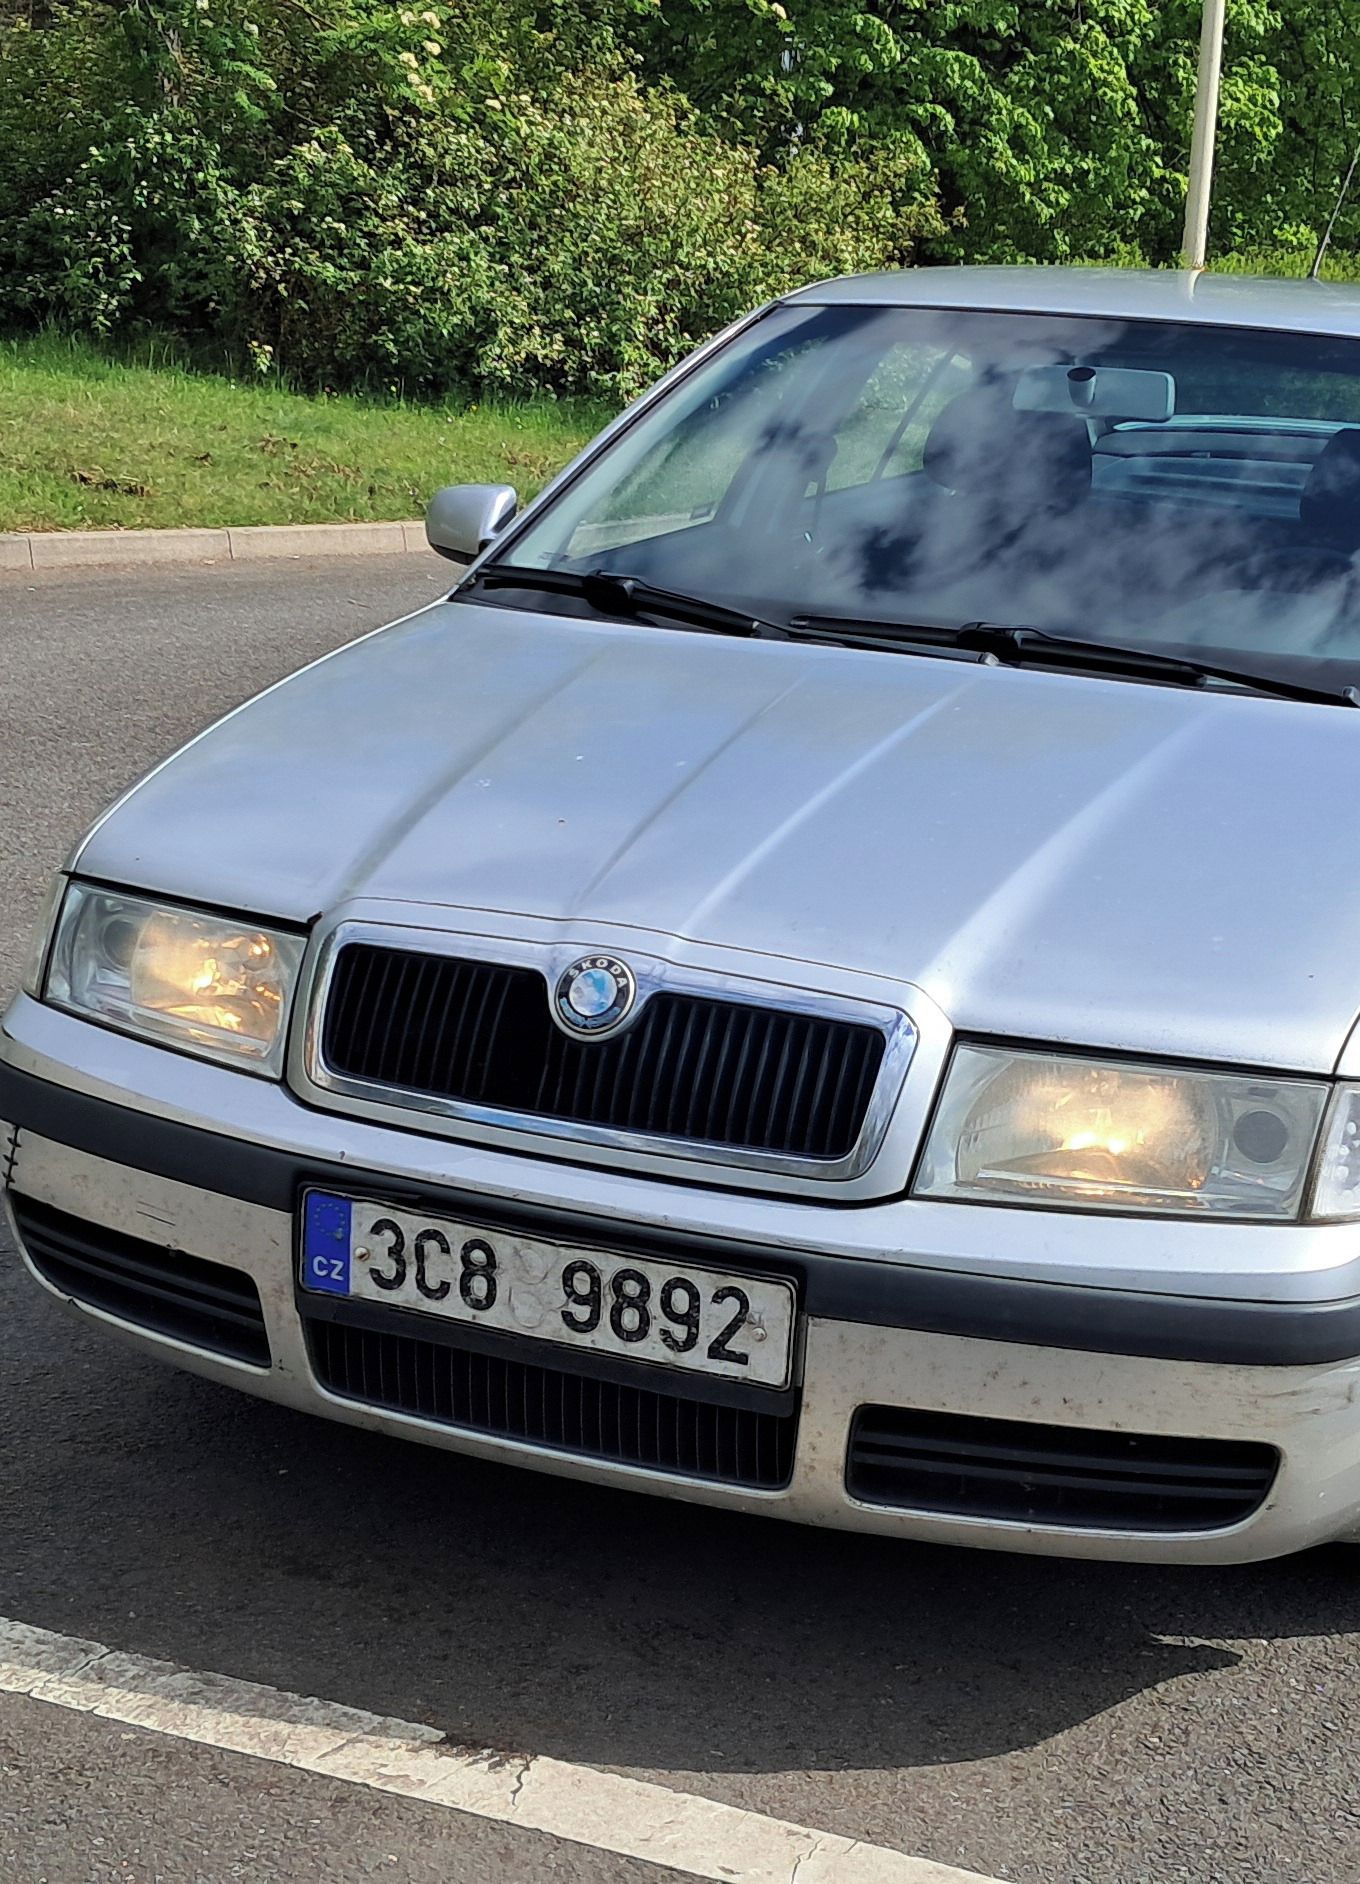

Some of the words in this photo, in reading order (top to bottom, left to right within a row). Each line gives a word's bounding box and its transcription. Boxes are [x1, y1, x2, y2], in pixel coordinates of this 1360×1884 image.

[313, 1255, 344, 1281] CZ
[368, 1218, 498, 1311] 3C8
[561, 1258, 749, 1366] 9892
